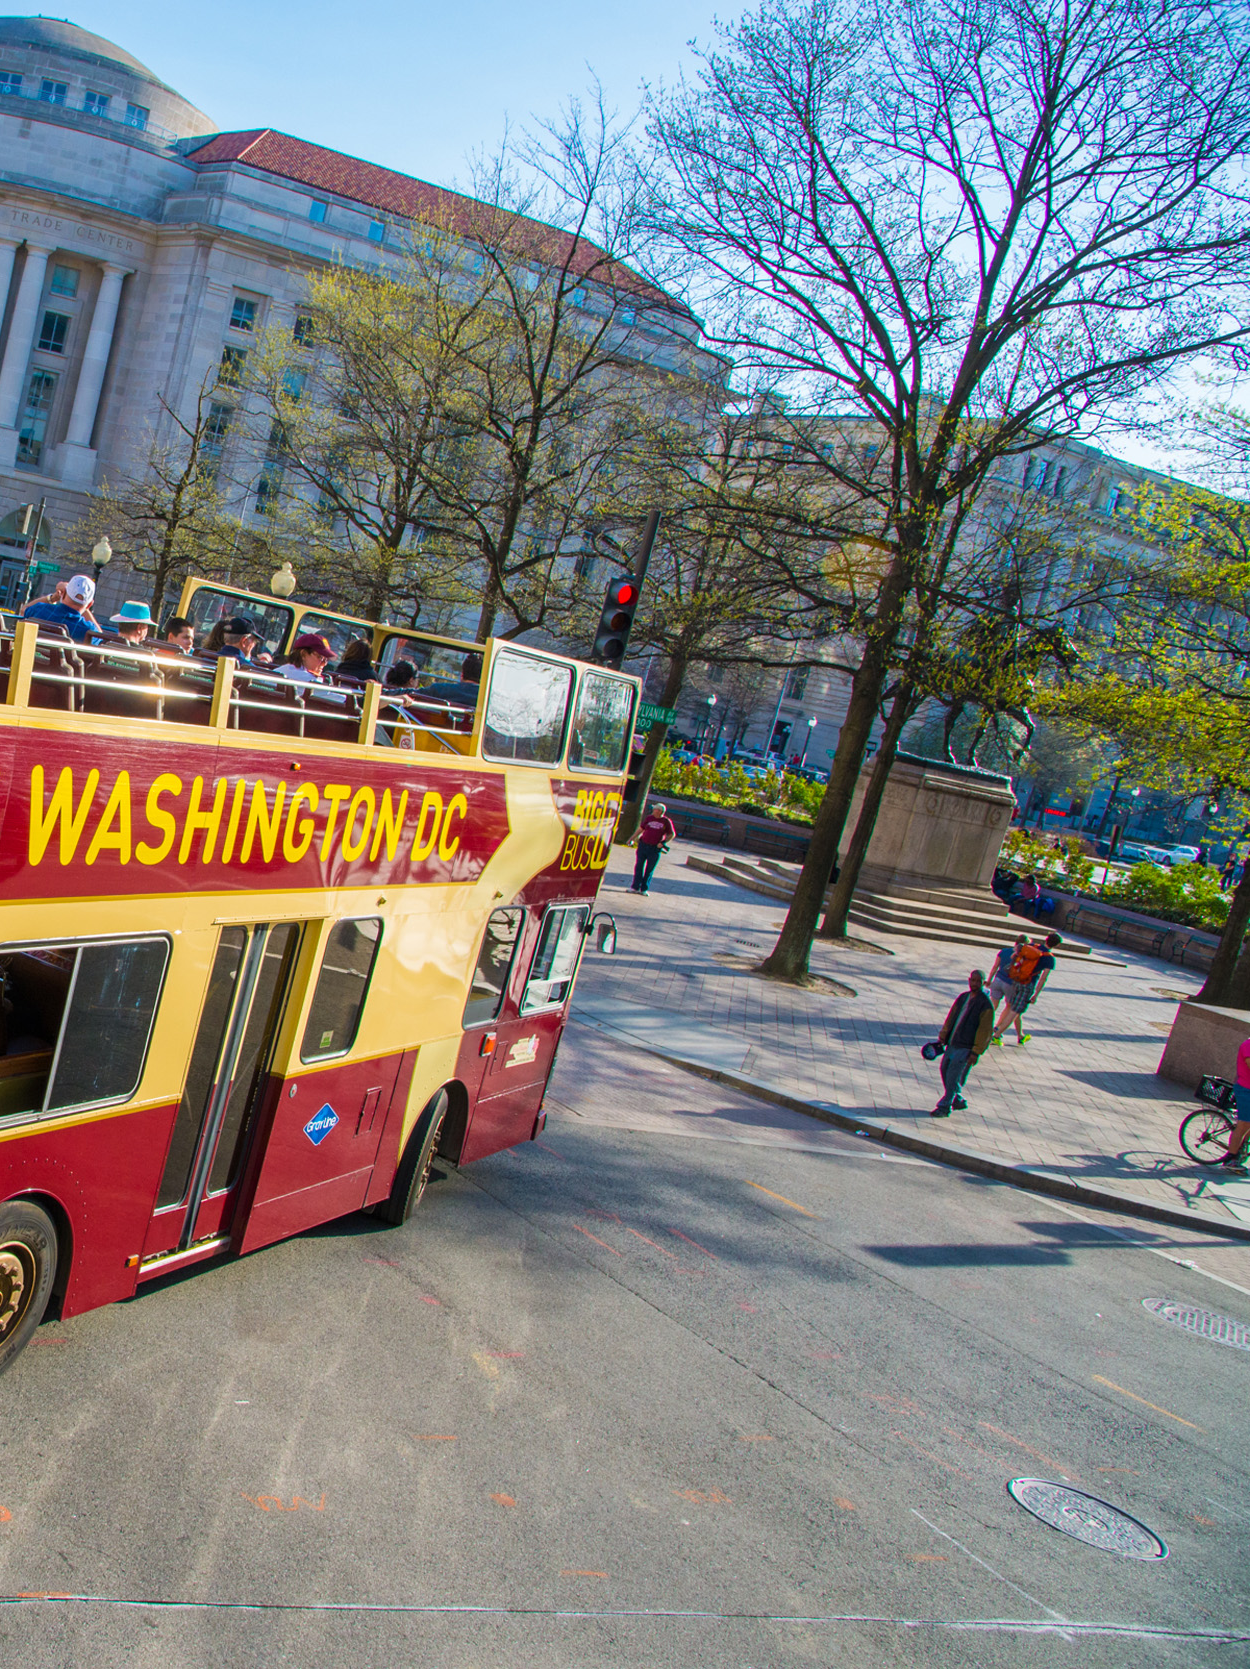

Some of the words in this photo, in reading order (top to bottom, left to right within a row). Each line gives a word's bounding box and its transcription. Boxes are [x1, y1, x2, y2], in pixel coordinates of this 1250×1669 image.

[11, 209, 63, 231] TRADE
[76, 226, 134, 251] CENTER
[637, 705, 665, 723] YLVANIA
[28, 764, 409, 867] WASHINGTON
[410, 790, 468, 863] DC
[570, 789, 605, 831] BIG
[559, 834, 596, 871] BUS
